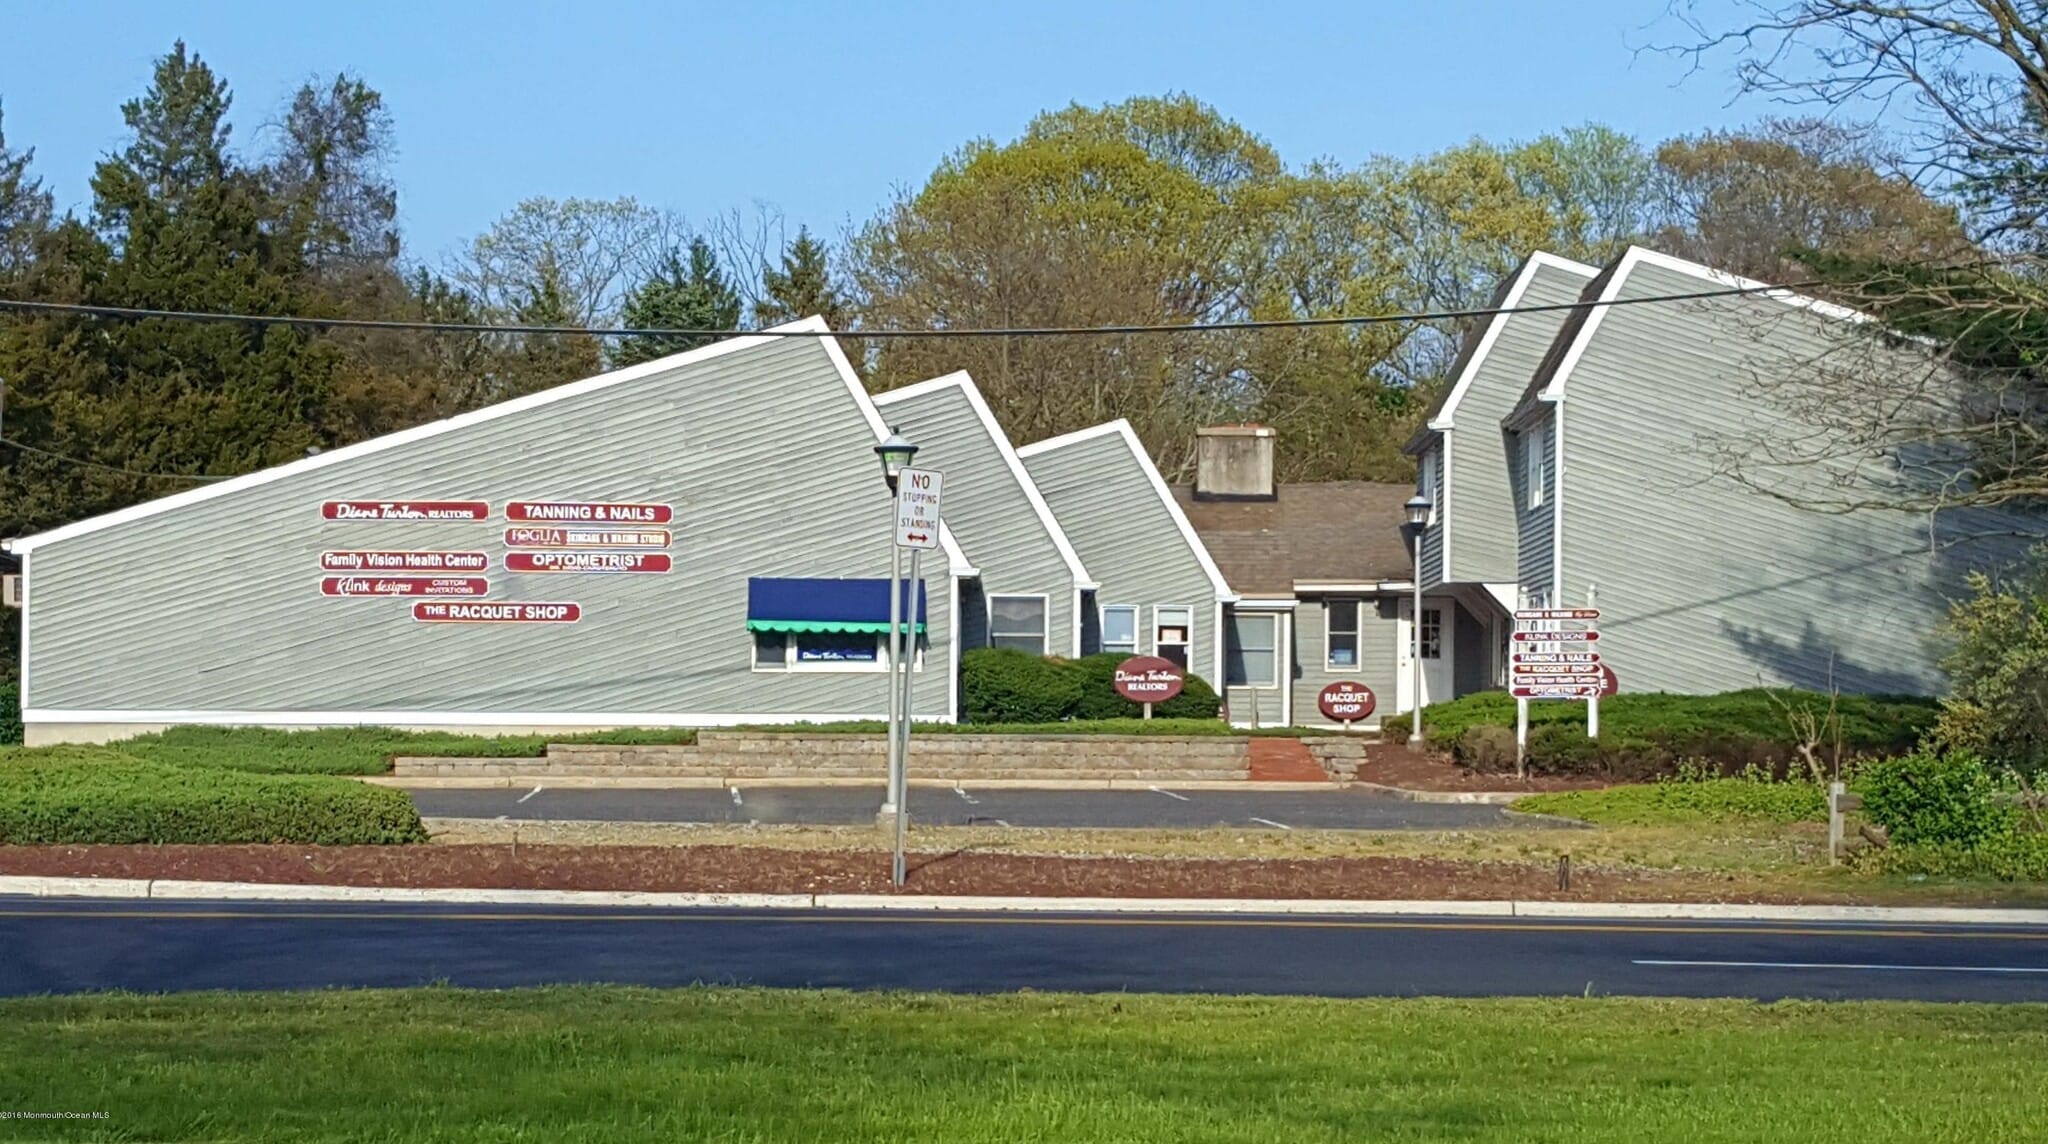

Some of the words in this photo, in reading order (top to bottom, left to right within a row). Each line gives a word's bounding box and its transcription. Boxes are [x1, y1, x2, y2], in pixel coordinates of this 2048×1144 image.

[912, 473, 930, 489] NO
[903, 491, 937, 504] STOPPING
[336, 504, 378, 519] Diane
[428, 510, 474, 519] REALTORS
[524, 505, 591, 519] TANNING
[595, 506, 606, 519] &
[610, 507, 655, 520] NAILS
[914, 505, 925, 516] OR
[901, 517, 936, 530] STANDING
[603, 532, 609, 543] &
[325, 553, 363, 569] Family
[367, 554, 402, 566] Vision
[406, 554, 442, 566] Health
[445, 554, 484, 567] Center
[532, 555, 645, 567] OPTOMETRIST
[375, 579, 412, 596] designs
[432, 579, 467, 587] CUSTOM
[425, 586, 474, 594] INVITATIONS
[424, 605, 446, 615] THE
[450, 606, 522, 619] RACQUET
[525, 606, 568, 619] SHOP
[1551, 632, 1587, 640] DESIGNS
[1520, 654, 1557, 662] TANNING
[1559, 654, 1565, 662] &
[1115, 670, 1145, 681] Diane
[1516, 676, 1536, 685] Family
[1127, 682, 1168, 691] REALTORS
[1341, 684, 1353, 692] THE
[1529, 687, 1581, 695] OPTOMETRIST
[1324, 692, 1370, 703] RACQUET
[1333, 704, 1361, 713] SHOP
